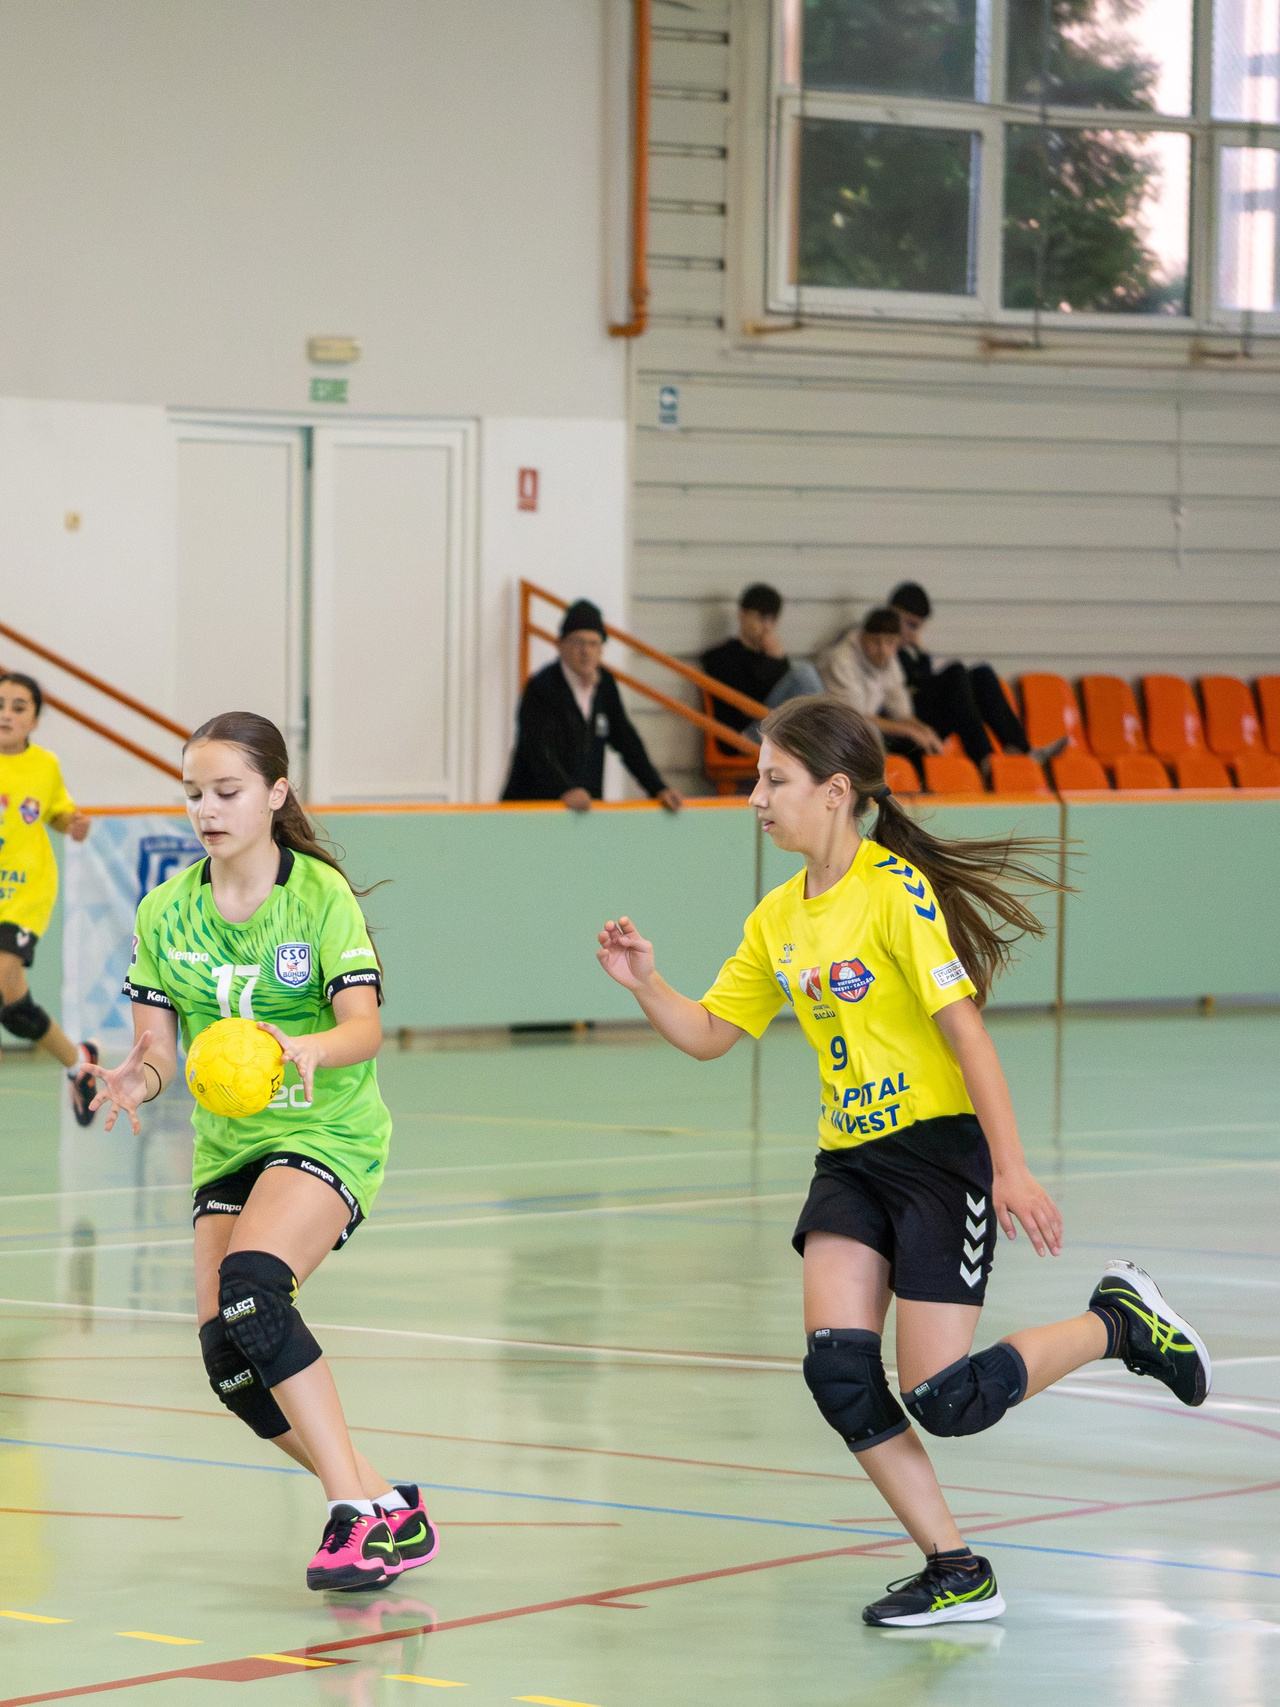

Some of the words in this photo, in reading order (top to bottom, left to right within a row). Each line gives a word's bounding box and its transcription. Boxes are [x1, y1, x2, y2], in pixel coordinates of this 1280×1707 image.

[167, 947, 209, 965] Kempa
[280, 948, 307, 960] CSO
[342, 973, 376, 985] Kempa
[147, 991, 172, 1006] Kem
[211, 963, 260, 1020] 17
[830, 1035, 848, 1071] 9
[833, 1072, 910, 1108] PITAL
[830, 1103, 901, 1134] INVEST
[301, 1160, 334, 1183] Kempa
[207, 1200, 243, 1212] Kempa
[223, 1297, 255, 1319] SELECT
[219, 1368, 252, 1390] SELECT
